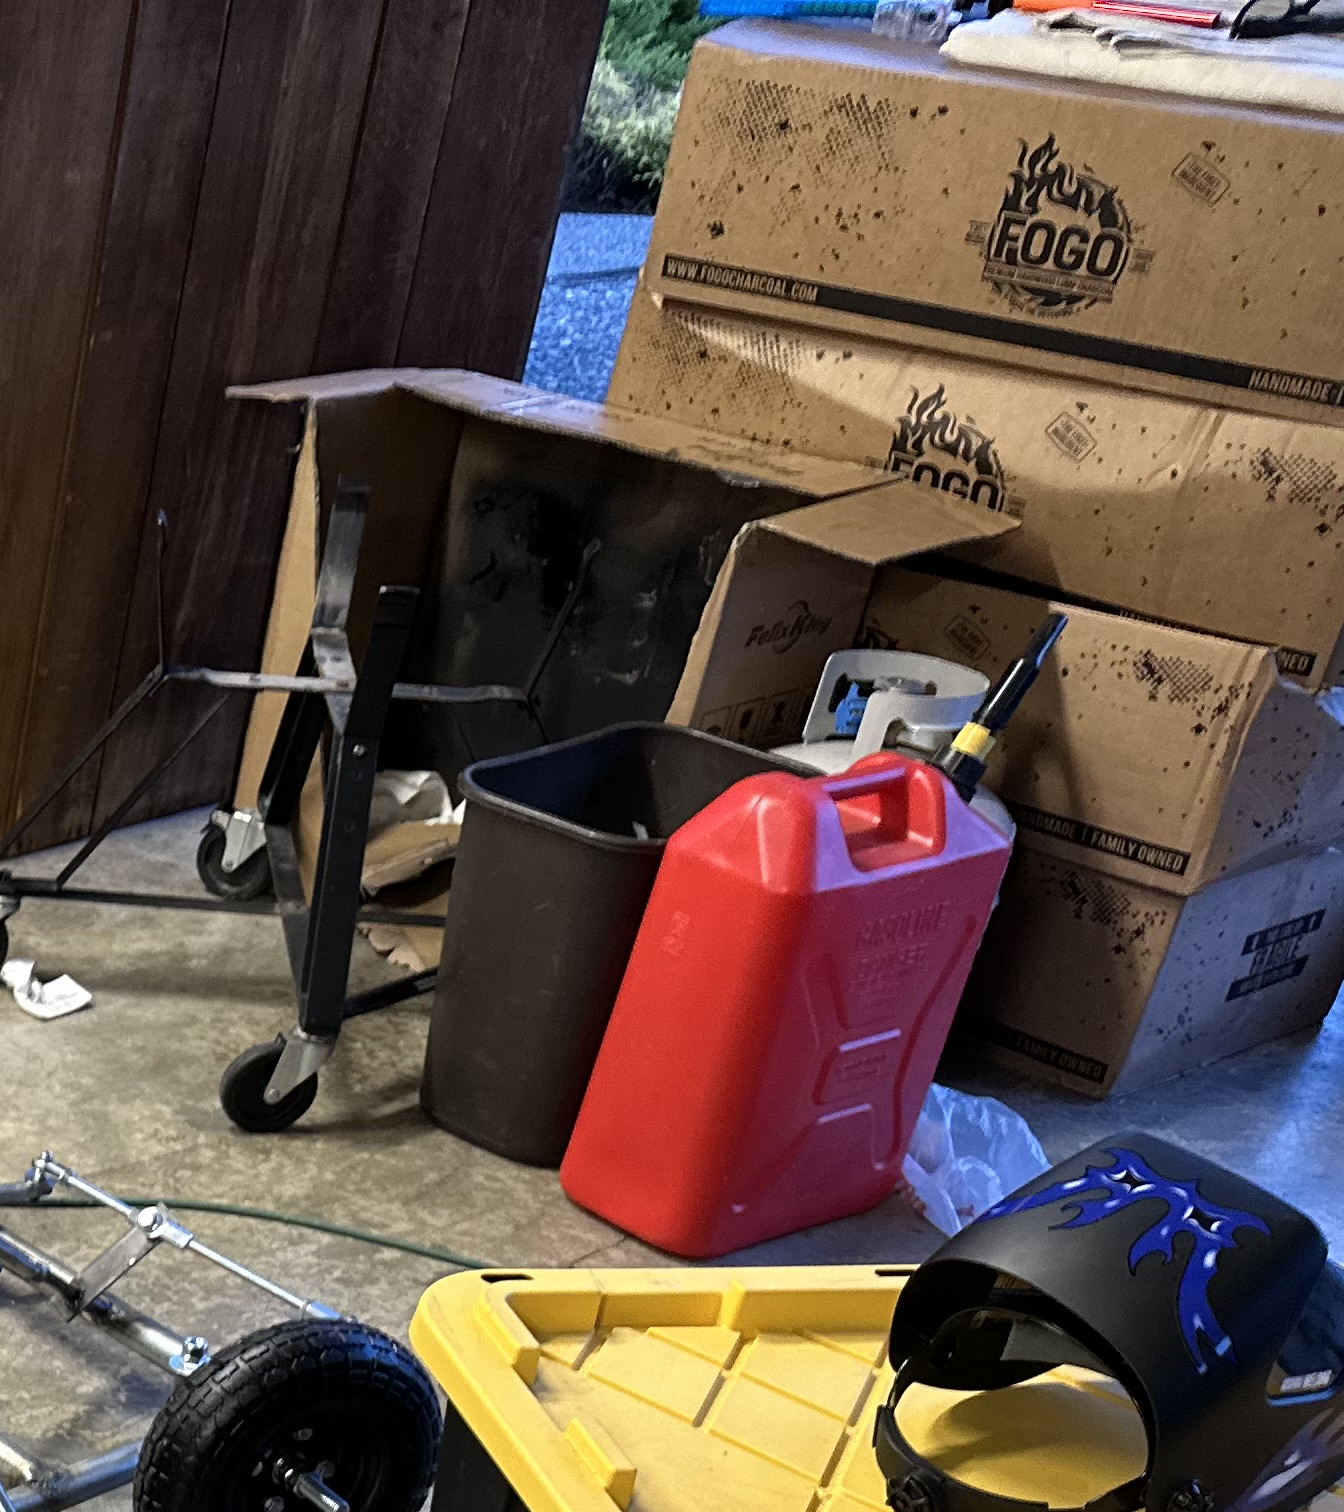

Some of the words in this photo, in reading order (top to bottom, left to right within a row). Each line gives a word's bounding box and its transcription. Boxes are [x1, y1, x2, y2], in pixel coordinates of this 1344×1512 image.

[992, 212, 1125, 278] FOGO
[1248, 368, 1333, 403] HANDMADE
[1089, 829, 1138, 858] FAMILY
[1137, 844, 1186, 873] OWNED
